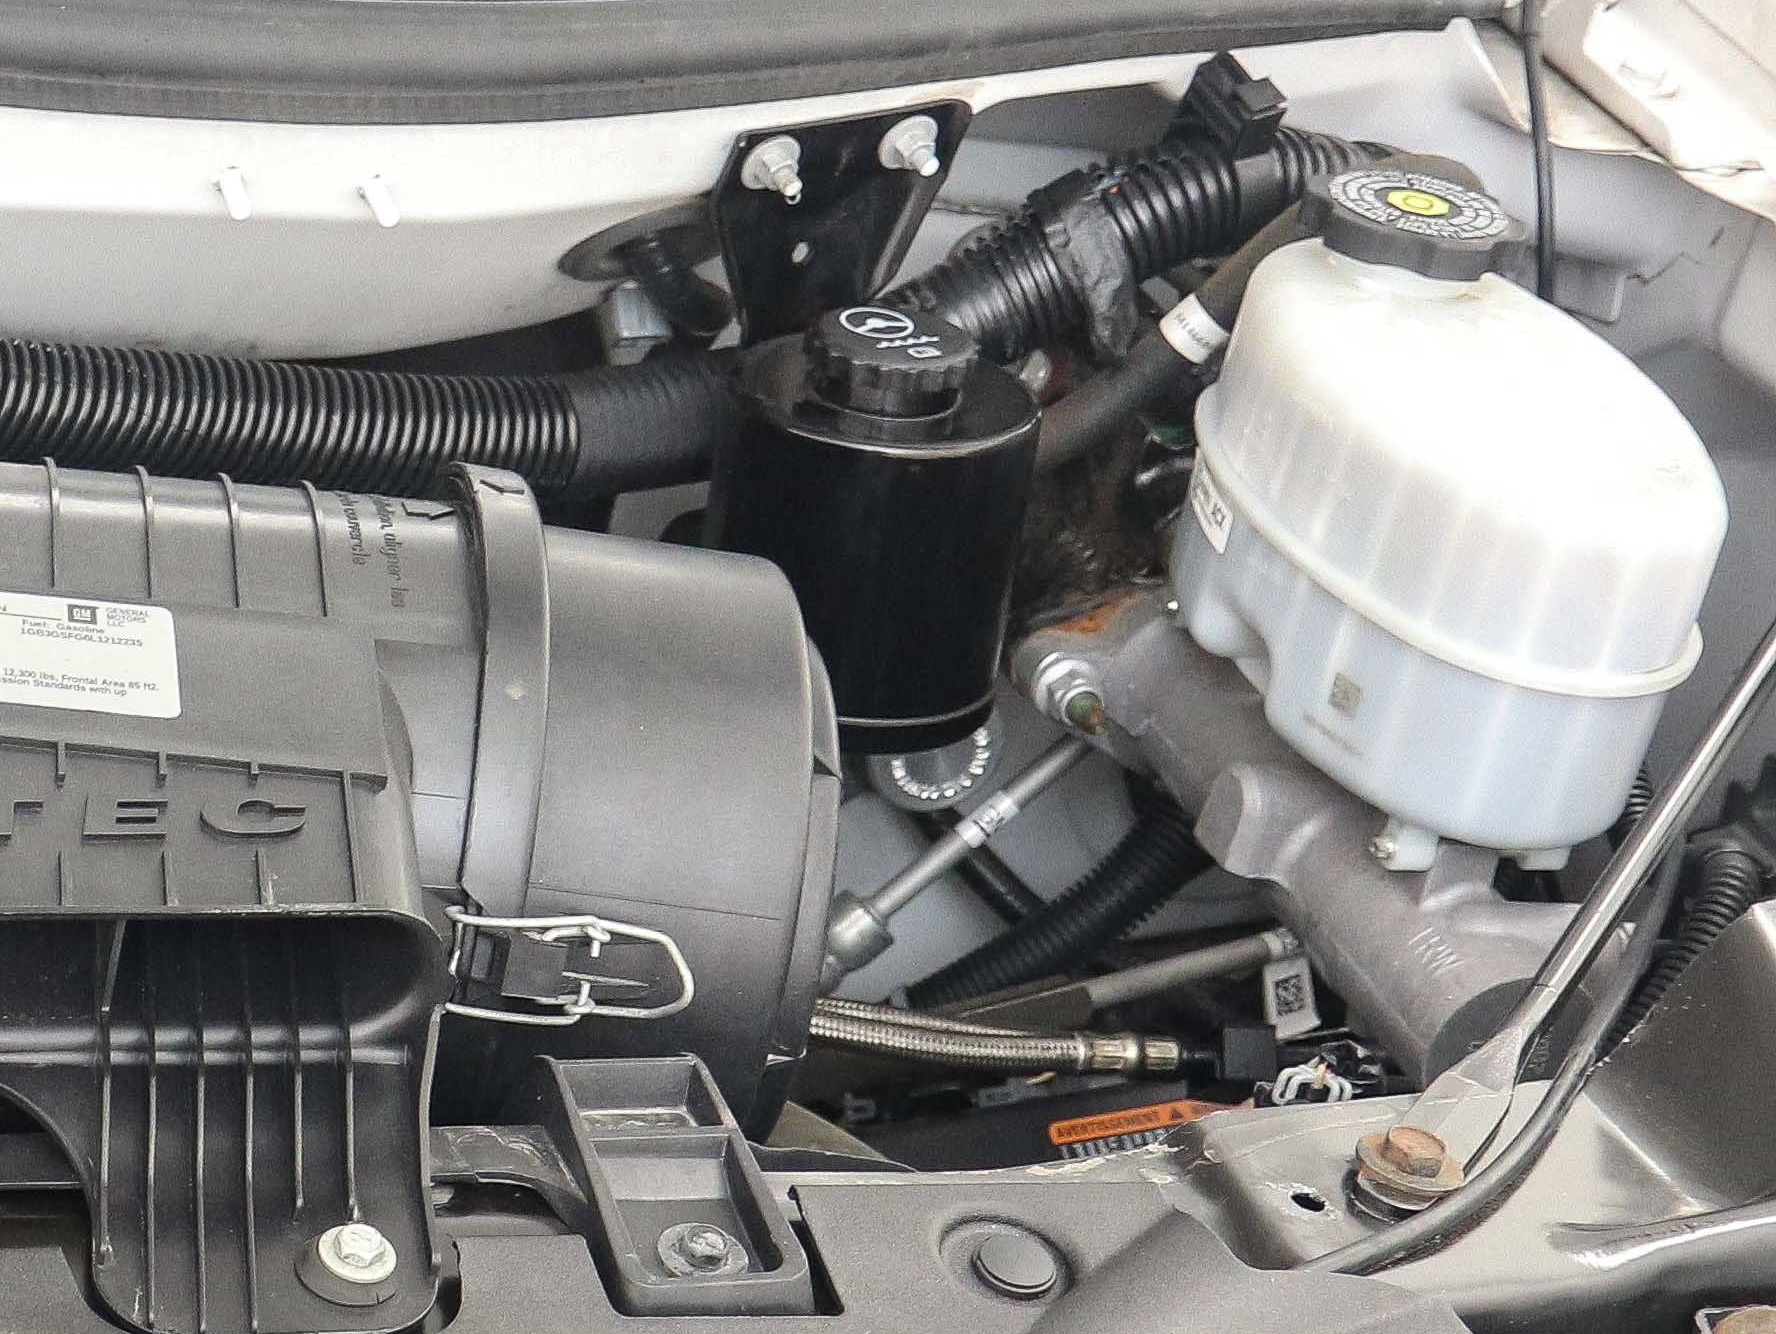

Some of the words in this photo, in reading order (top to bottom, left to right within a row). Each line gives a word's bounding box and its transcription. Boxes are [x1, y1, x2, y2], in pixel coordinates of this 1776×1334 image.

[56, 623, 104, 634] Gasoline
[33, 679, 86, 692] Standards
[114, 688, 127, 697] up
[62, 674, 98, 685] Frontal
[101, 679, 125, 688] Area
